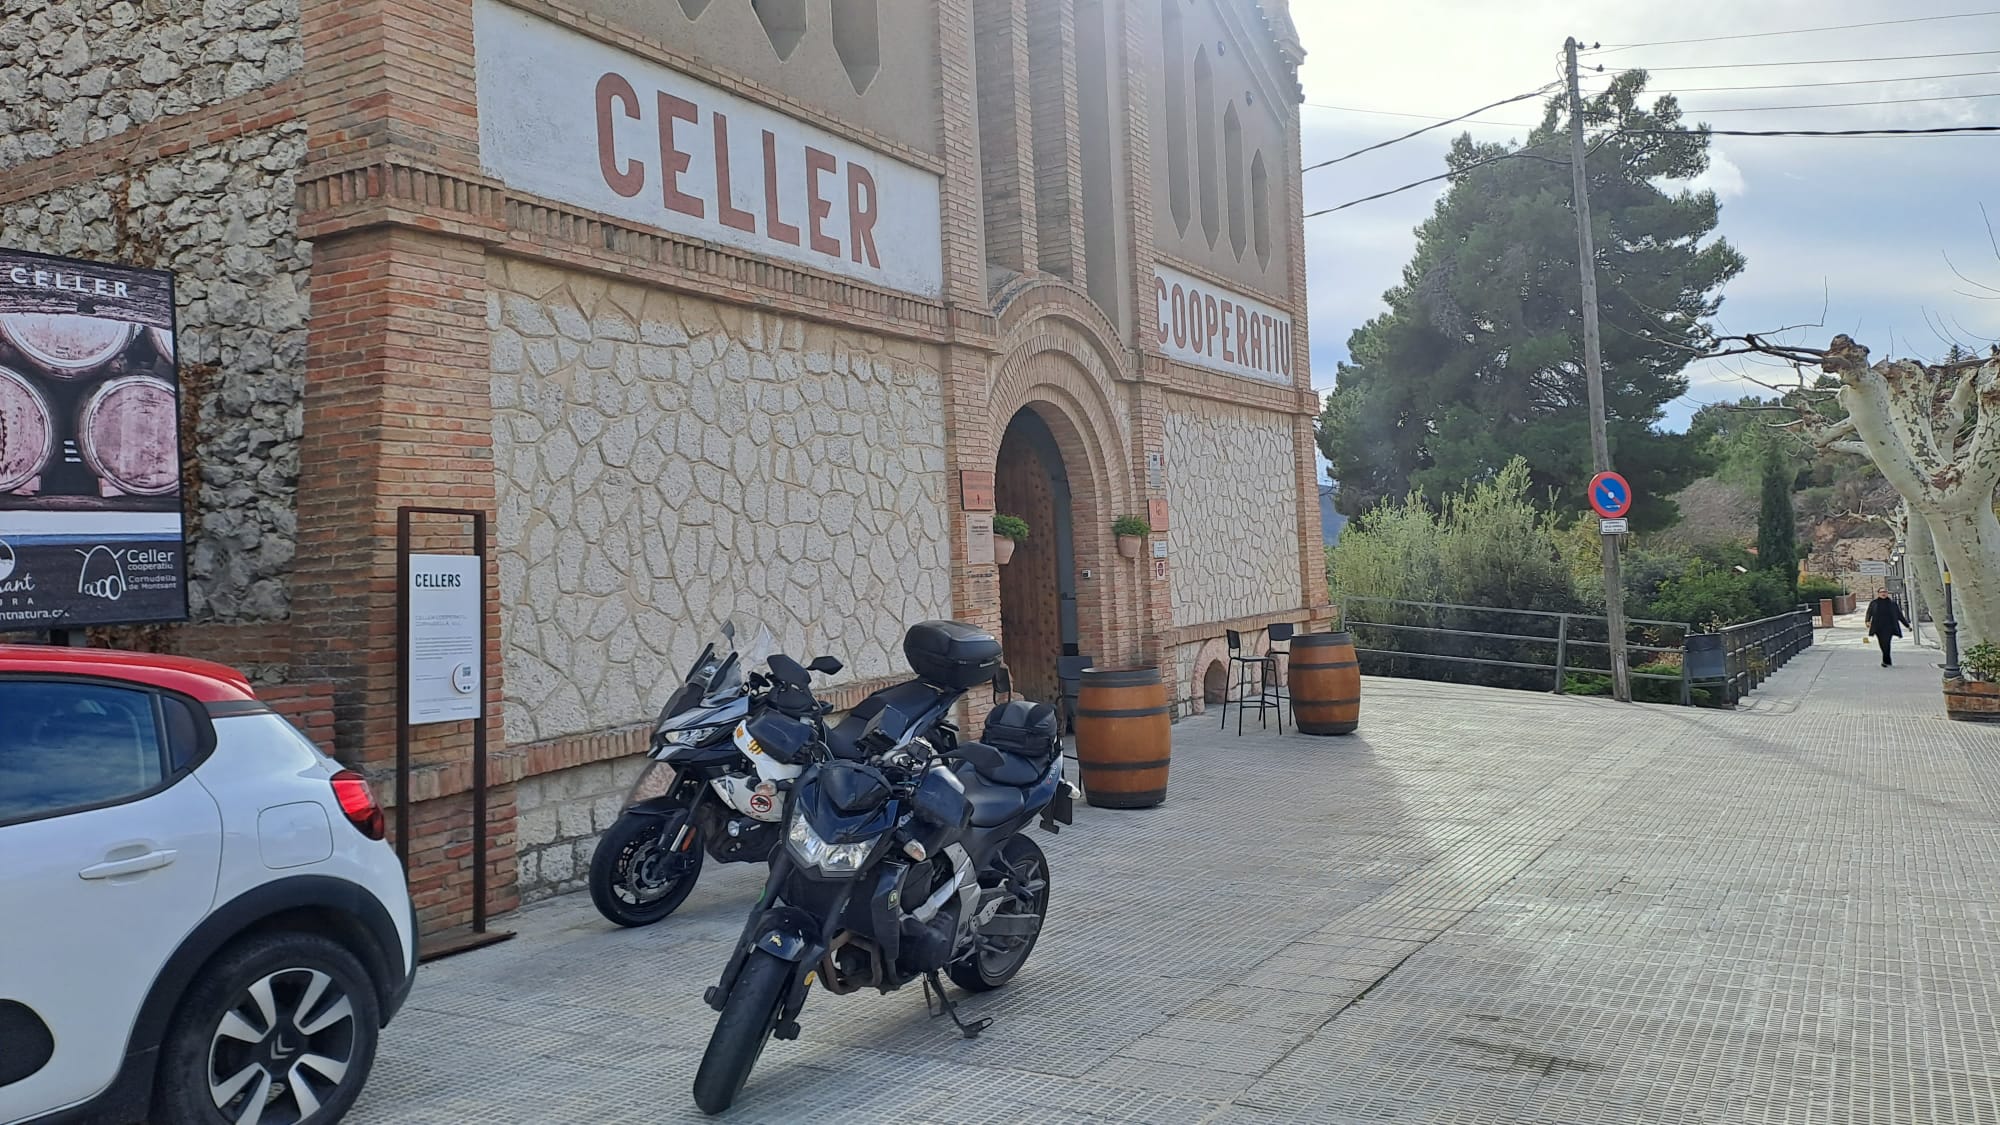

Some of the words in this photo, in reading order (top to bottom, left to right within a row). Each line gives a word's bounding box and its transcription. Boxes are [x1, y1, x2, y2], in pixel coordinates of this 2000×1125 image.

[595, 72, 880, 270] CELLER
[10, 267, 129, 298] CELLER
[1154, 276, 1291, 377] COOPERATIU
[127, 549, 175, 563] Celler
[0, 572, 36, 593] ant
[415, 573, 461, 588] CELLERS
